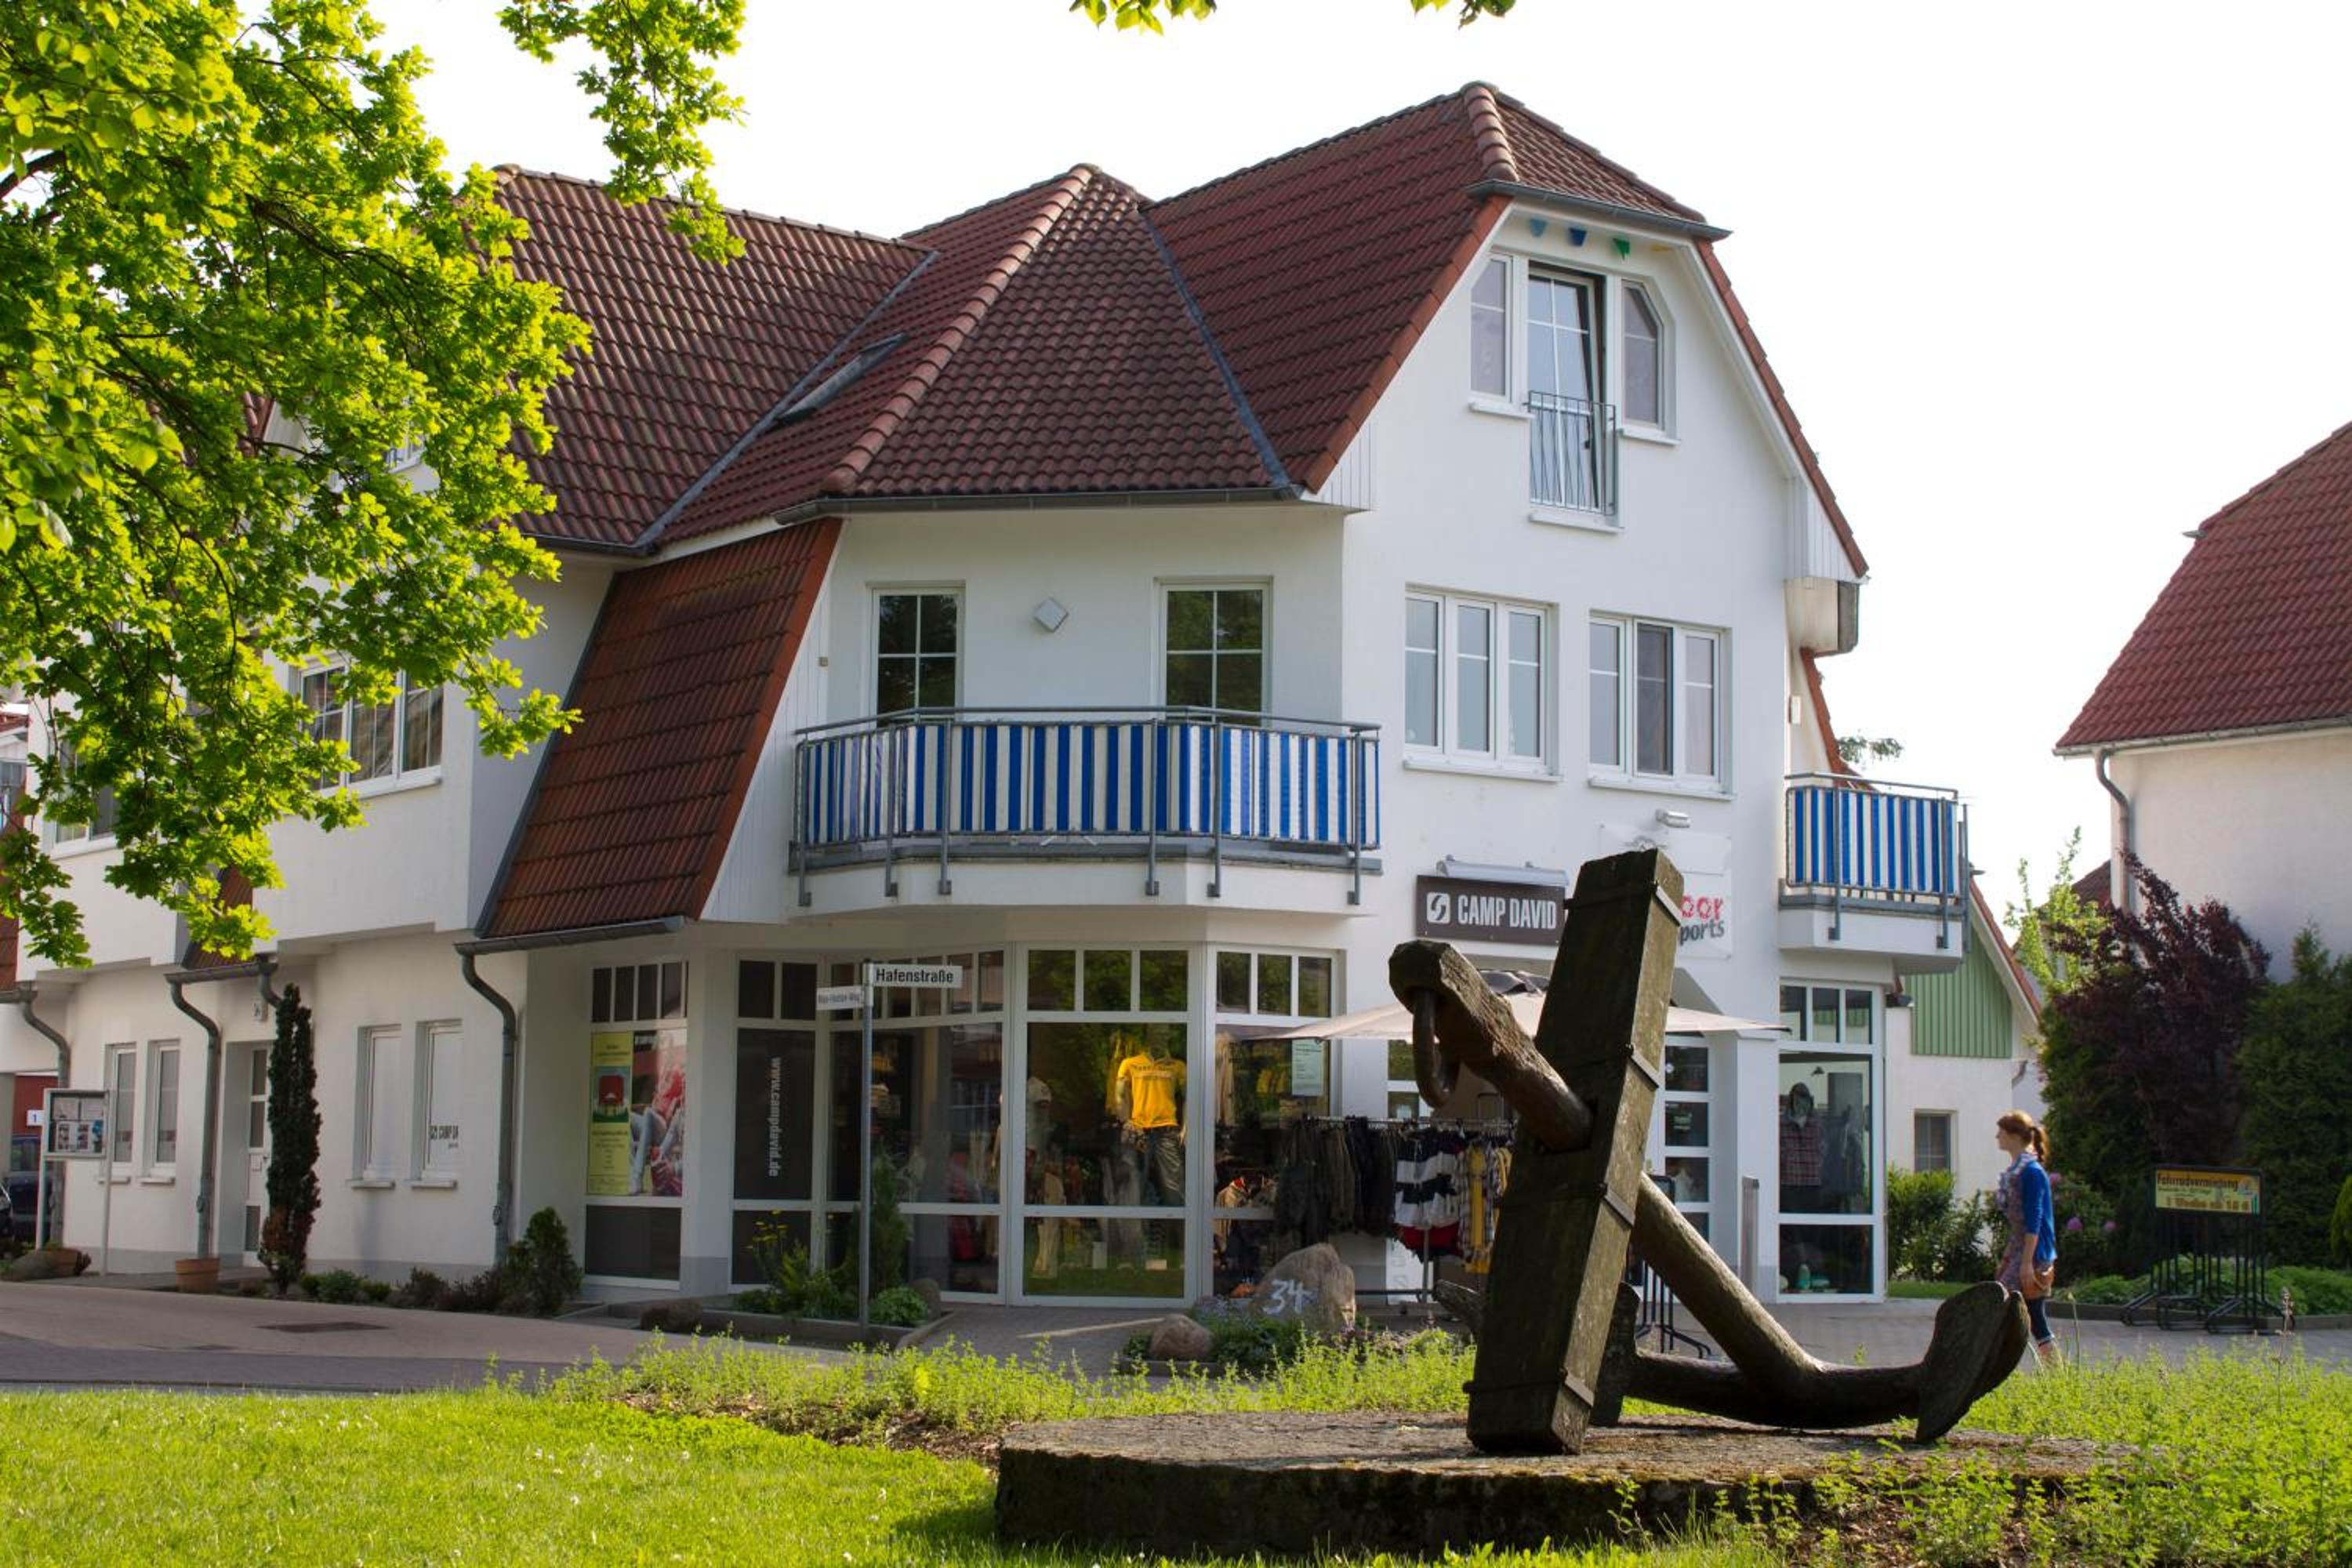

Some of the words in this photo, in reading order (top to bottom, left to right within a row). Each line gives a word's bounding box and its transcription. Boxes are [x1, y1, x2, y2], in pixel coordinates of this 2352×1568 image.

[1457, 894, 1506, 927] CAMP
[1509, 898, 1556, 930] DAVID
[1679, 919, 1725, 946] ports
[876, 968, 954, 984] Hafenstraße
[32, 1113, 37, 1123] 1
[768, 1057, 782, 1177] www.campdavid.de
[1261, 1279, 1313, 1316] 34
